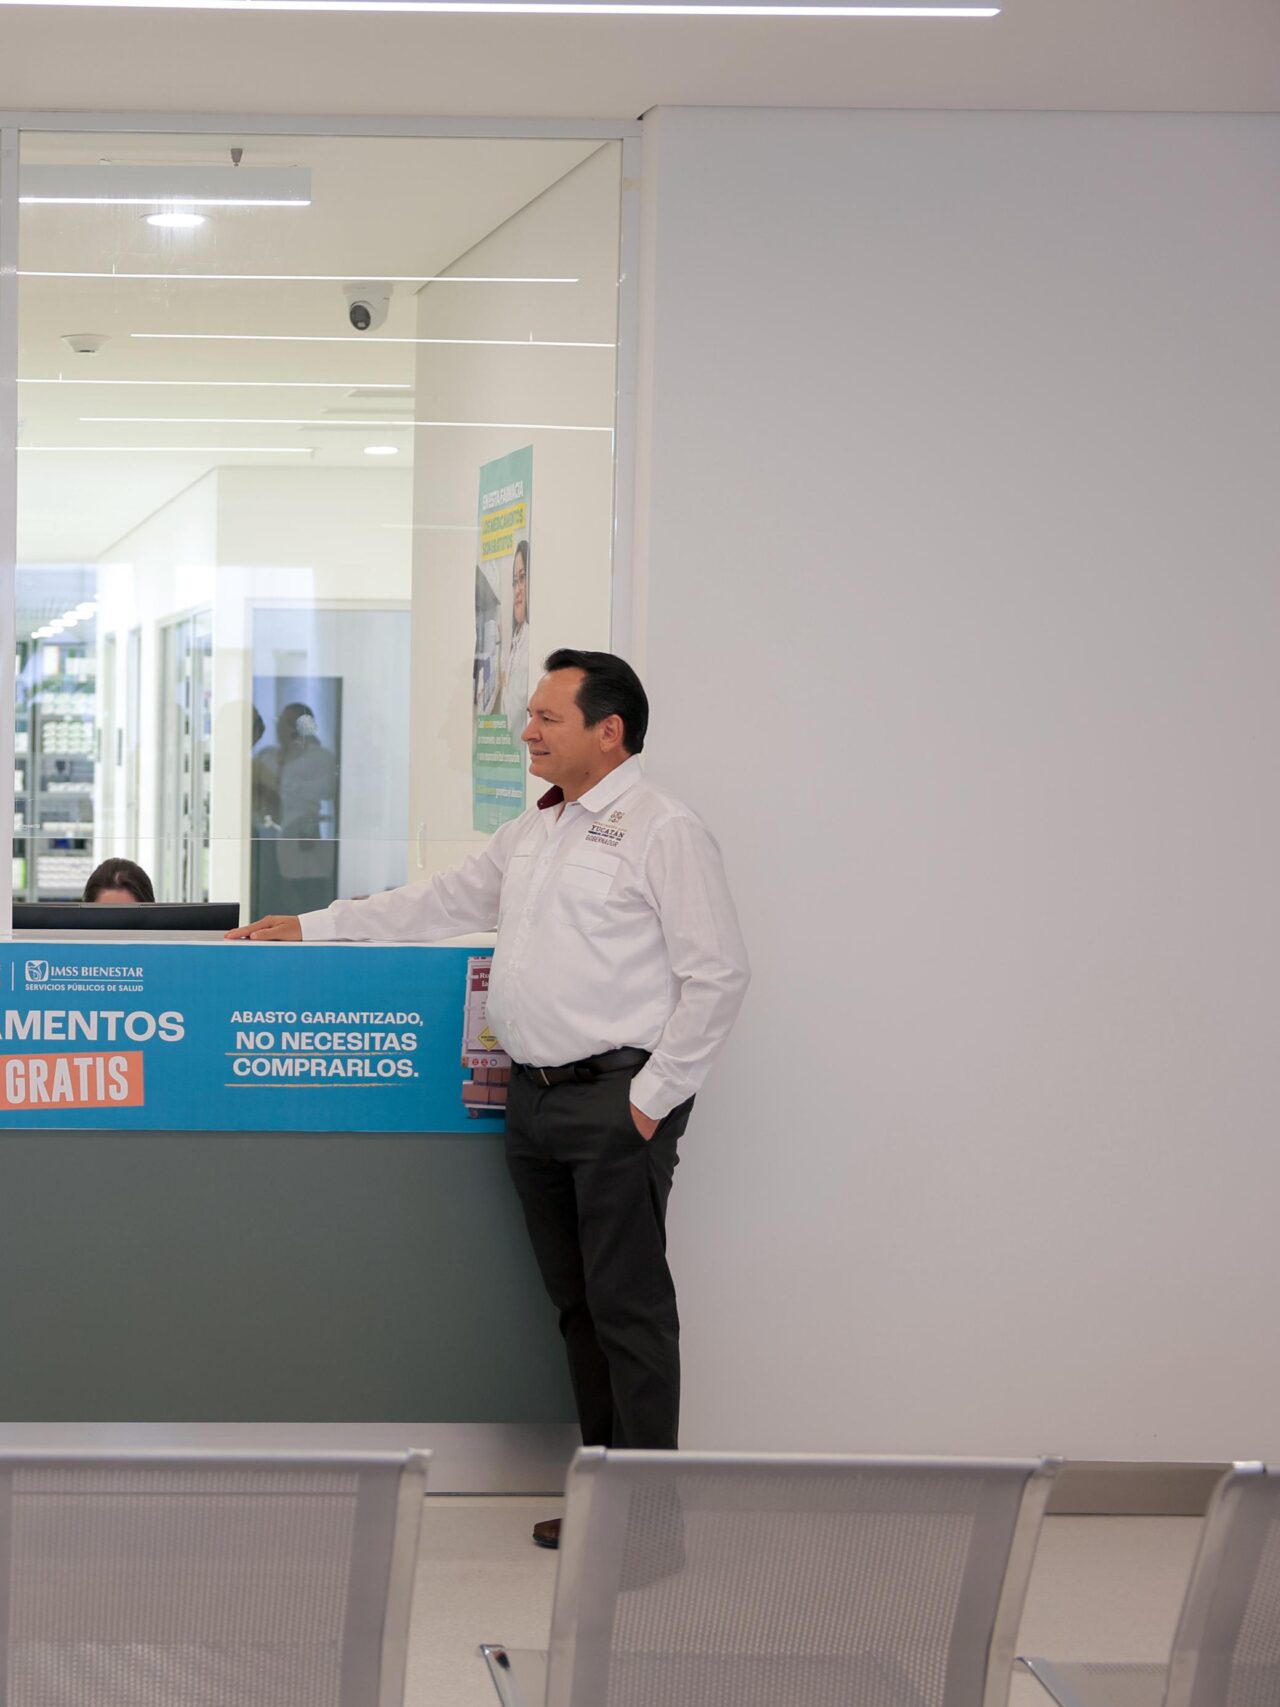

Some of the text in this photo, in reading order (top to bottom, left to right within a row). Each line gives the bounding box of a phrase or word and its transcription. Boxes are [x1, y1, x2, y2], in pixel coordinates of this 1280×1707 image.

[51, 966, 144, 978] IMSS BIENESTAR
[25, 982, 144, 992] SERVICIOS PÚBLICOS DE SALUD
[230, 1011, 424, 1027] ABASTO GARANTIZADO,
[236, 1031, 418, 1051] NO NECESITAS
[232, 1057, 419, 1078] COMPRARLOS.
[5, 1056, 129, 1104] GRATIS
